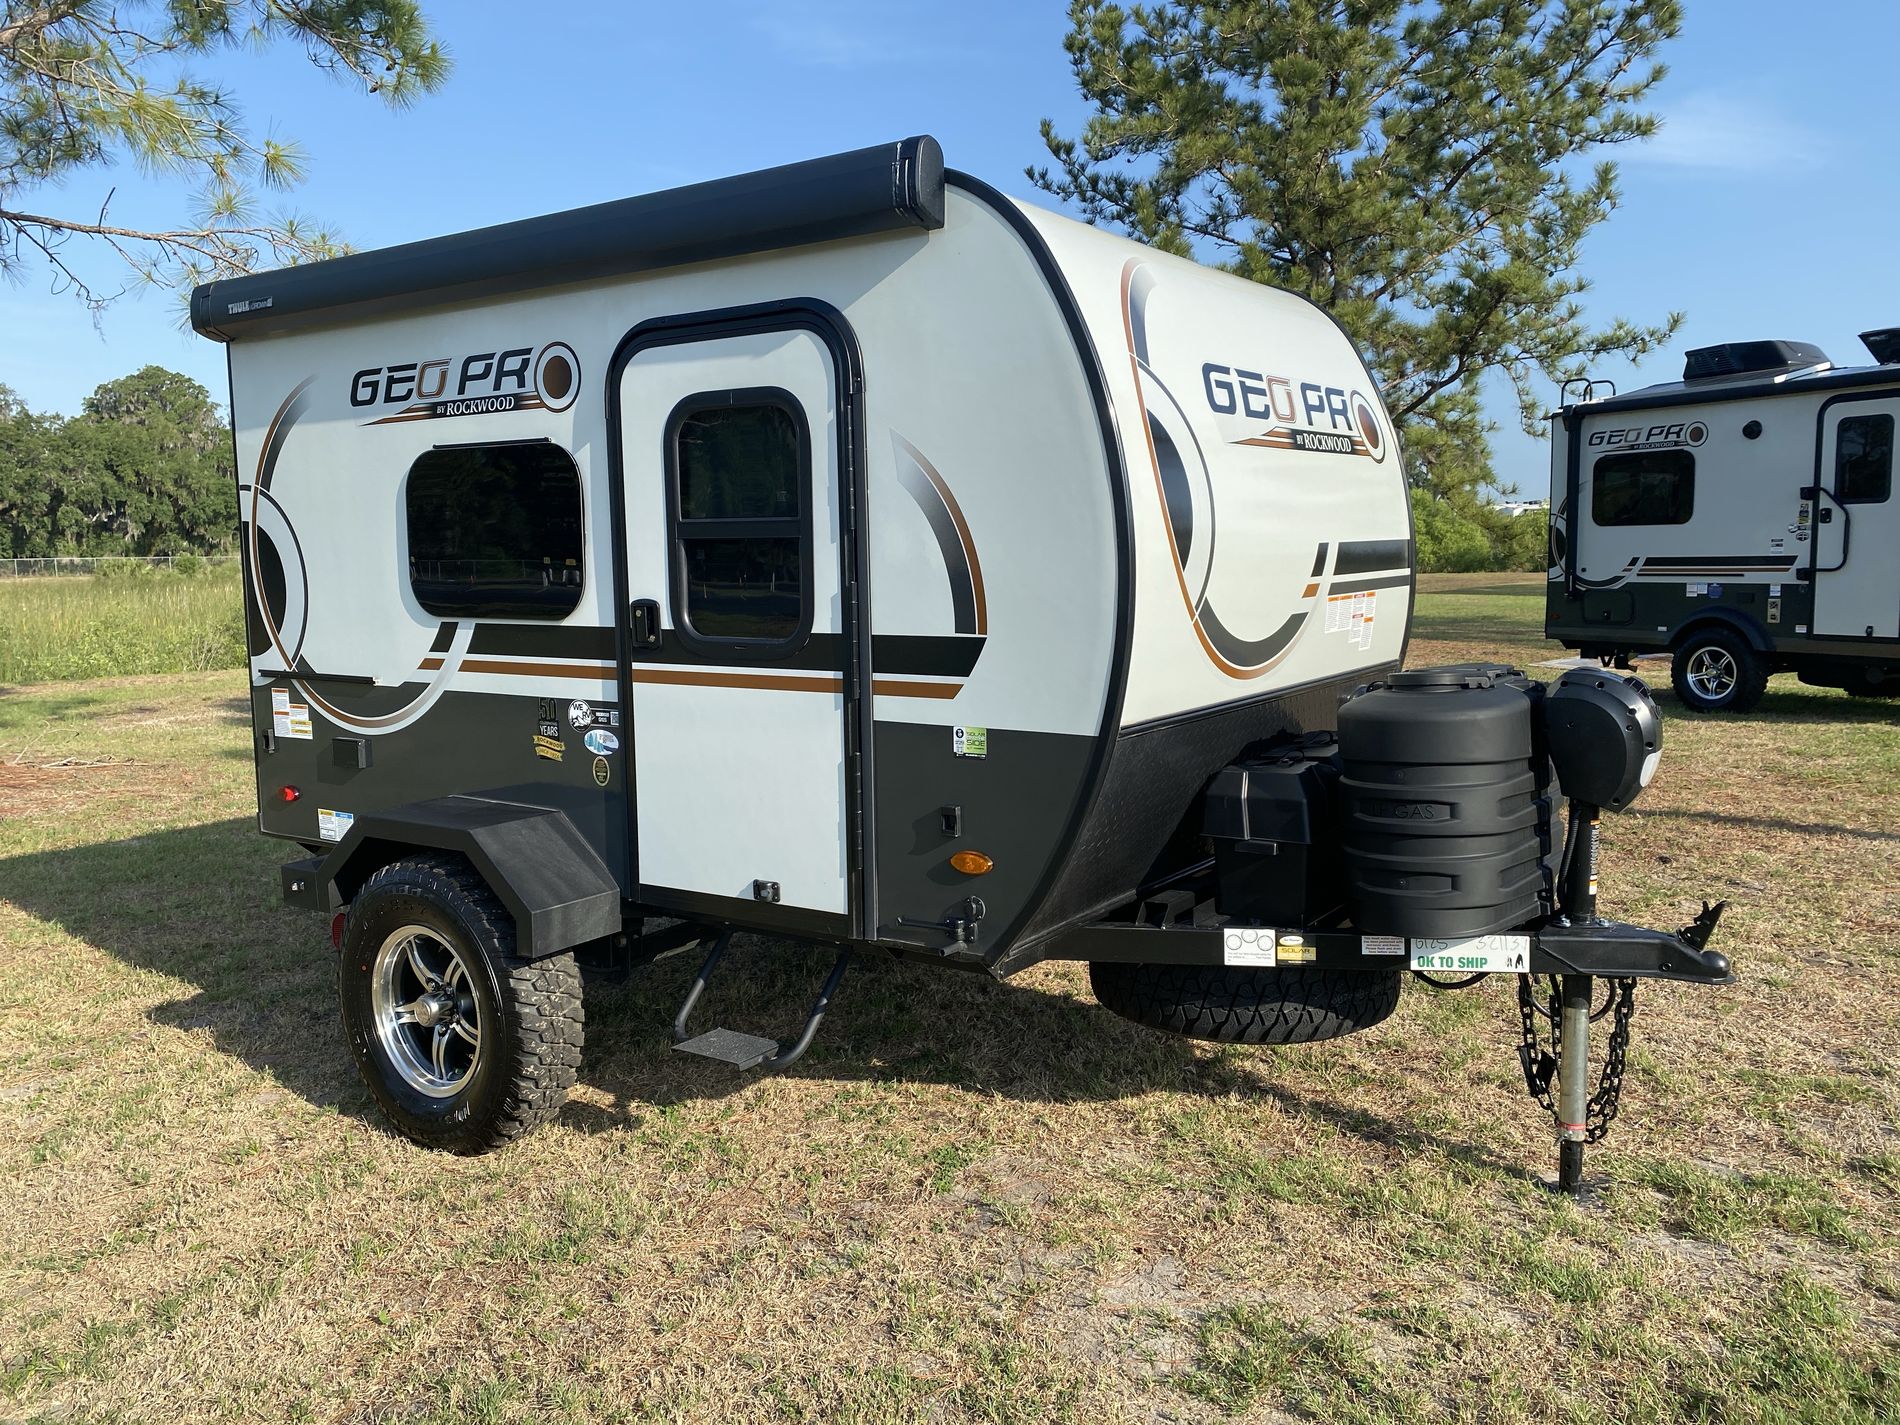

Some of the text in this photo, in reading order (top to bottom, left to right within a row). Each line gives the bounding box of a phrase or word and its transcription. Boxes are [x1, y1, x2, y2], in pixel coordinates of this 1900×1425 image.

[228, 300, 250, 315] THULE
[350, 358, 452, 408] GEO
[1202, 362, 1297, 424] GEO
[436, 396, 515, 416] BY ROCKWOOD
[1303, 432, 1352, 452] ROCKWOOD
[1588, 427, 1644, 446] GEO
[1640, 441, 1675, 449] ROCKWOOD
[572, 703, 584, 711] WE
[540, 725, 559, 737] YEARS
[536, 736, 564, 750] ROCKWOOD
[1394, 804, 1434, 820] GAS
[1417, 955, 1488, 969] OK TO SHIP
